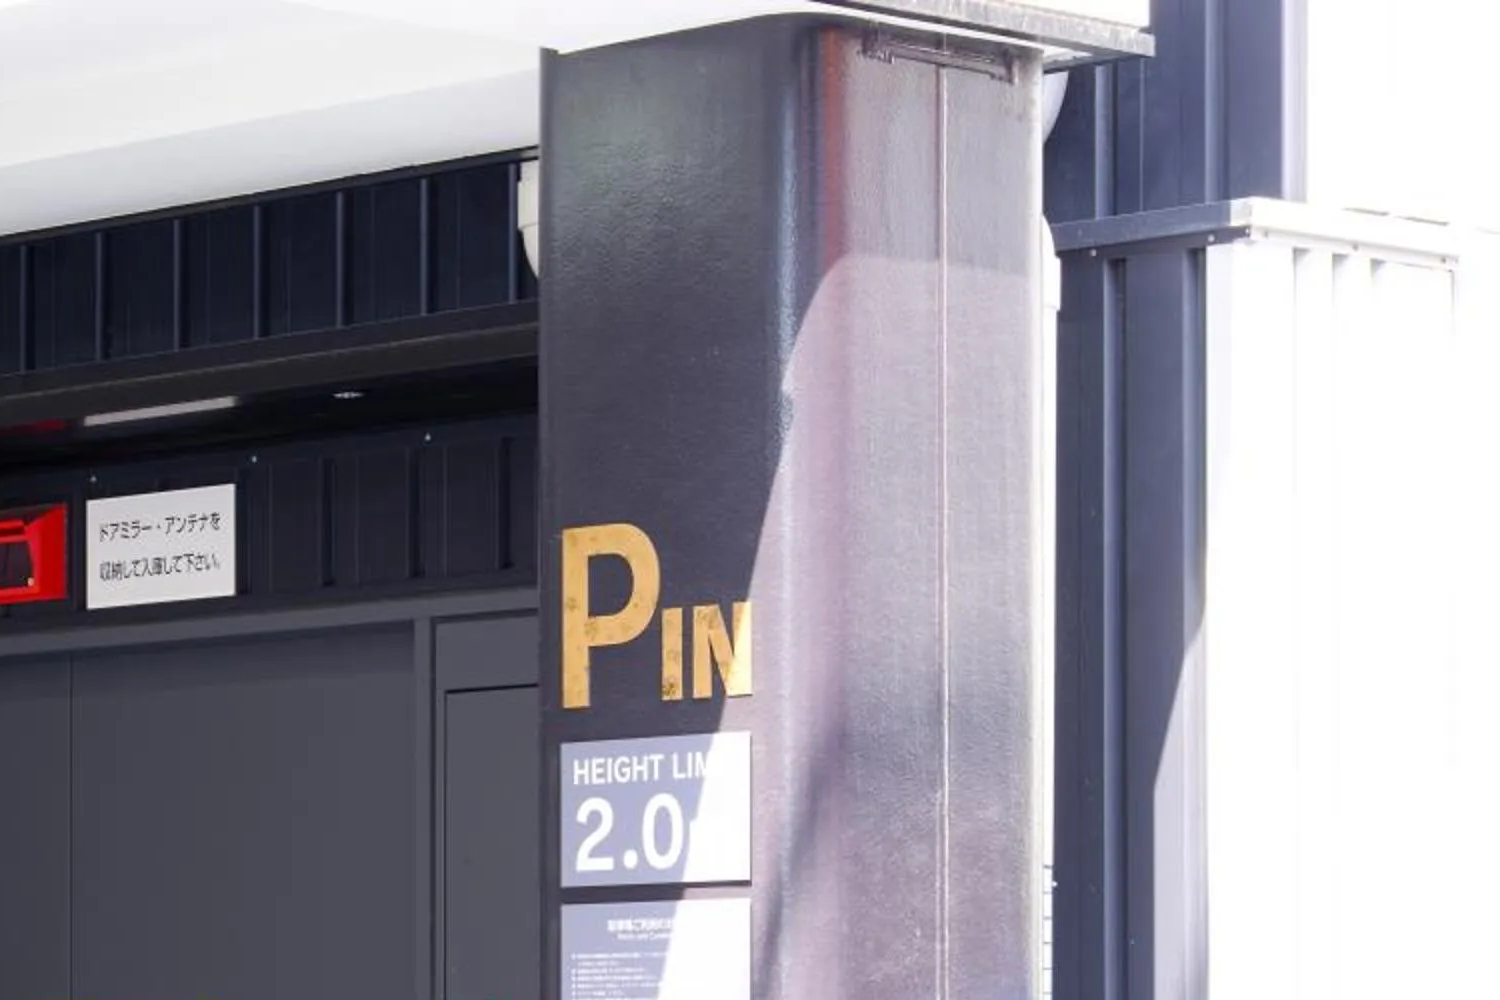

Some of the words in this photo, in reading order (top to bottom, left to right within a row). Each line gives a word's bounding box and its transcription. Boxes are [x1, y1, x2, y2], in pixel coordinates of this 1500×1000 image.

[100, 513, 221, 543] ドアミラー・アンテナを
[573, 755, 665, 785] HEIGHT
